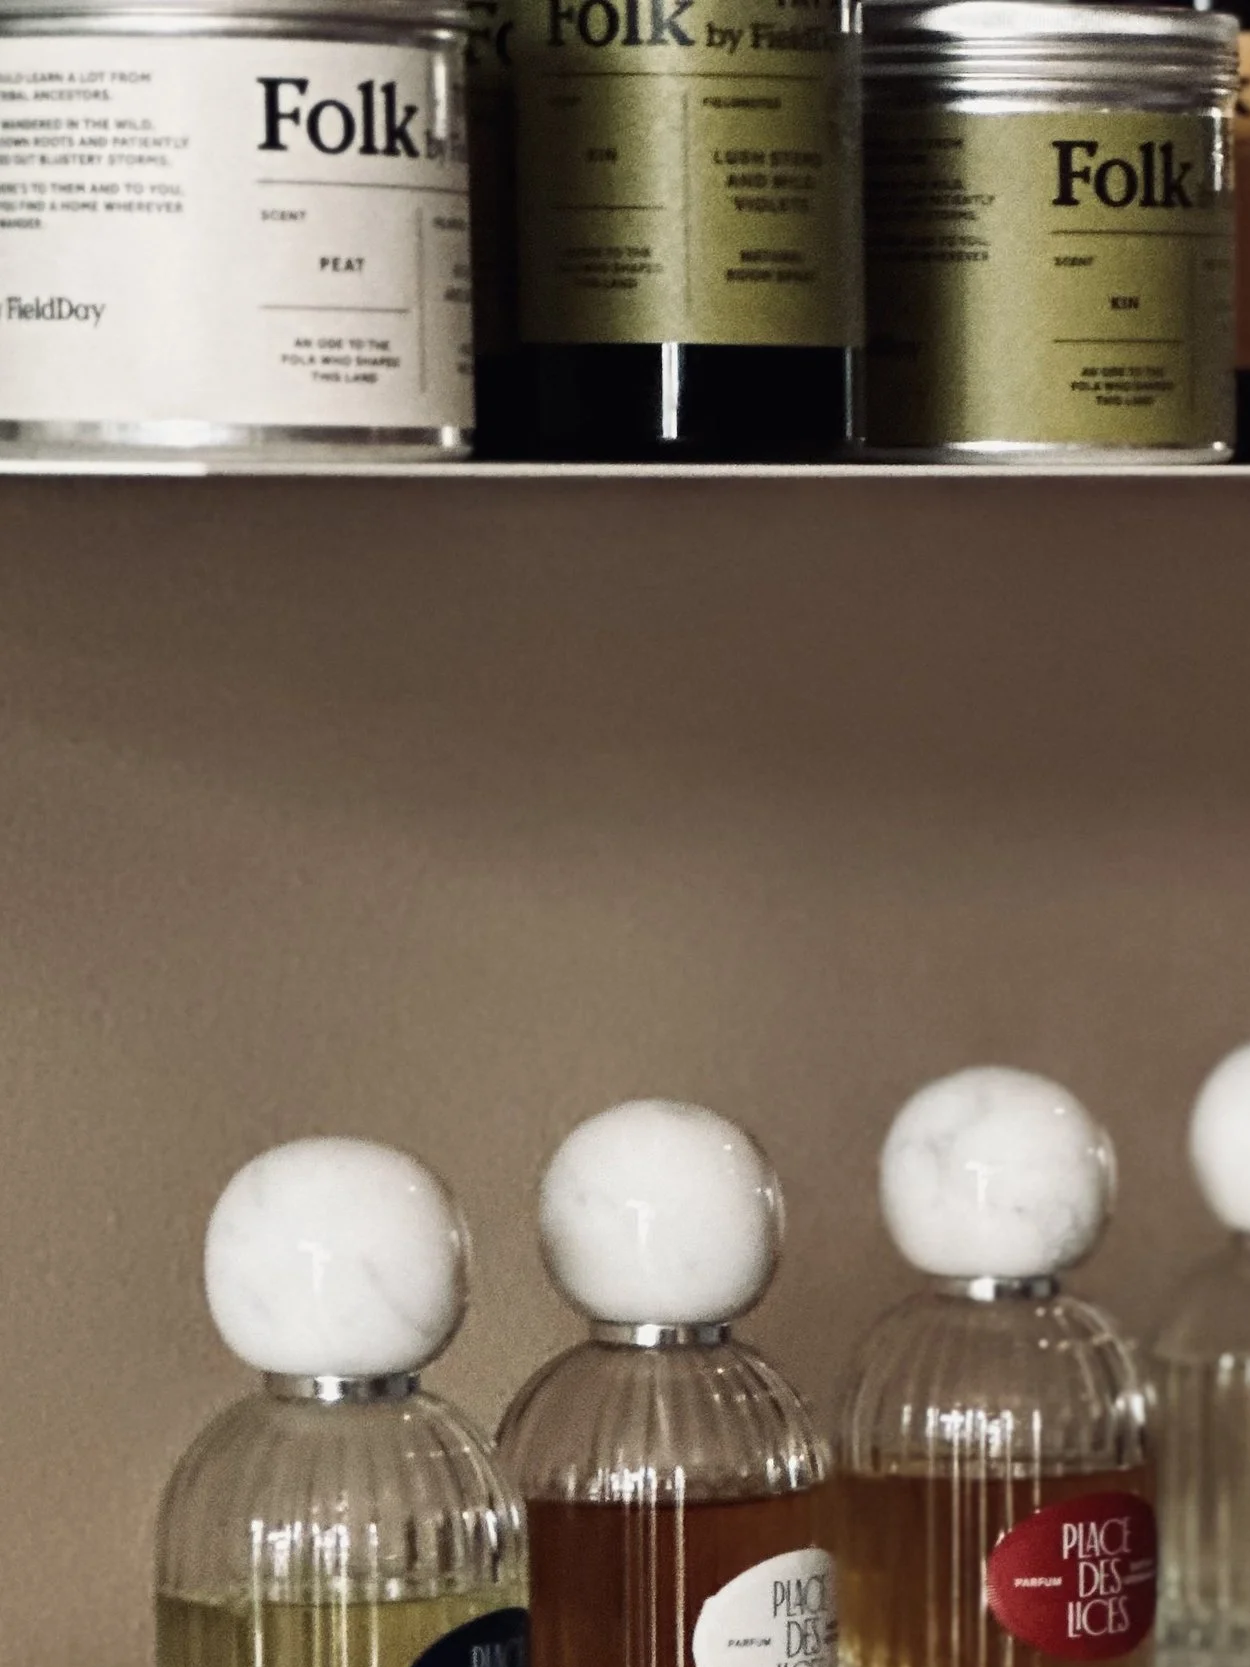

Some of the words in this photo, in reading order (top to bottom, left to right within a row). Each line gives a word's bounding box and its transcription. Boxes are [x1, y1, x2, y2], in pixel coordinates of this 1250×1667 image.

[706, 23, 744, 55] by
[111, 72, 152, 83] FROM
[84, 119, 109, 130] THE
[256, 77, 420, 158] Folk
[79, 137, 107, 148] AND
[112, 137, 189, 149] PATIENTLY
[1052, 140, 1194, 208] Folk
[125, 184, 144, 195] TO
[261, 211, 306, 221] SCENT
[319, 257, 365, 272] PEAT
[7, 295, 106, 329] FieldDay
[1062, 1517, 1132, 1560] PLACE
[1013, 1576, 1063, 1588] PARFUM
[1078, 1558, 1122, 1599] DES
[1066, 1596, 1130, 1638] LICES
[726, 1637, 772, 1648] PARFUM
[786, 1608, 823, 1658] DES
